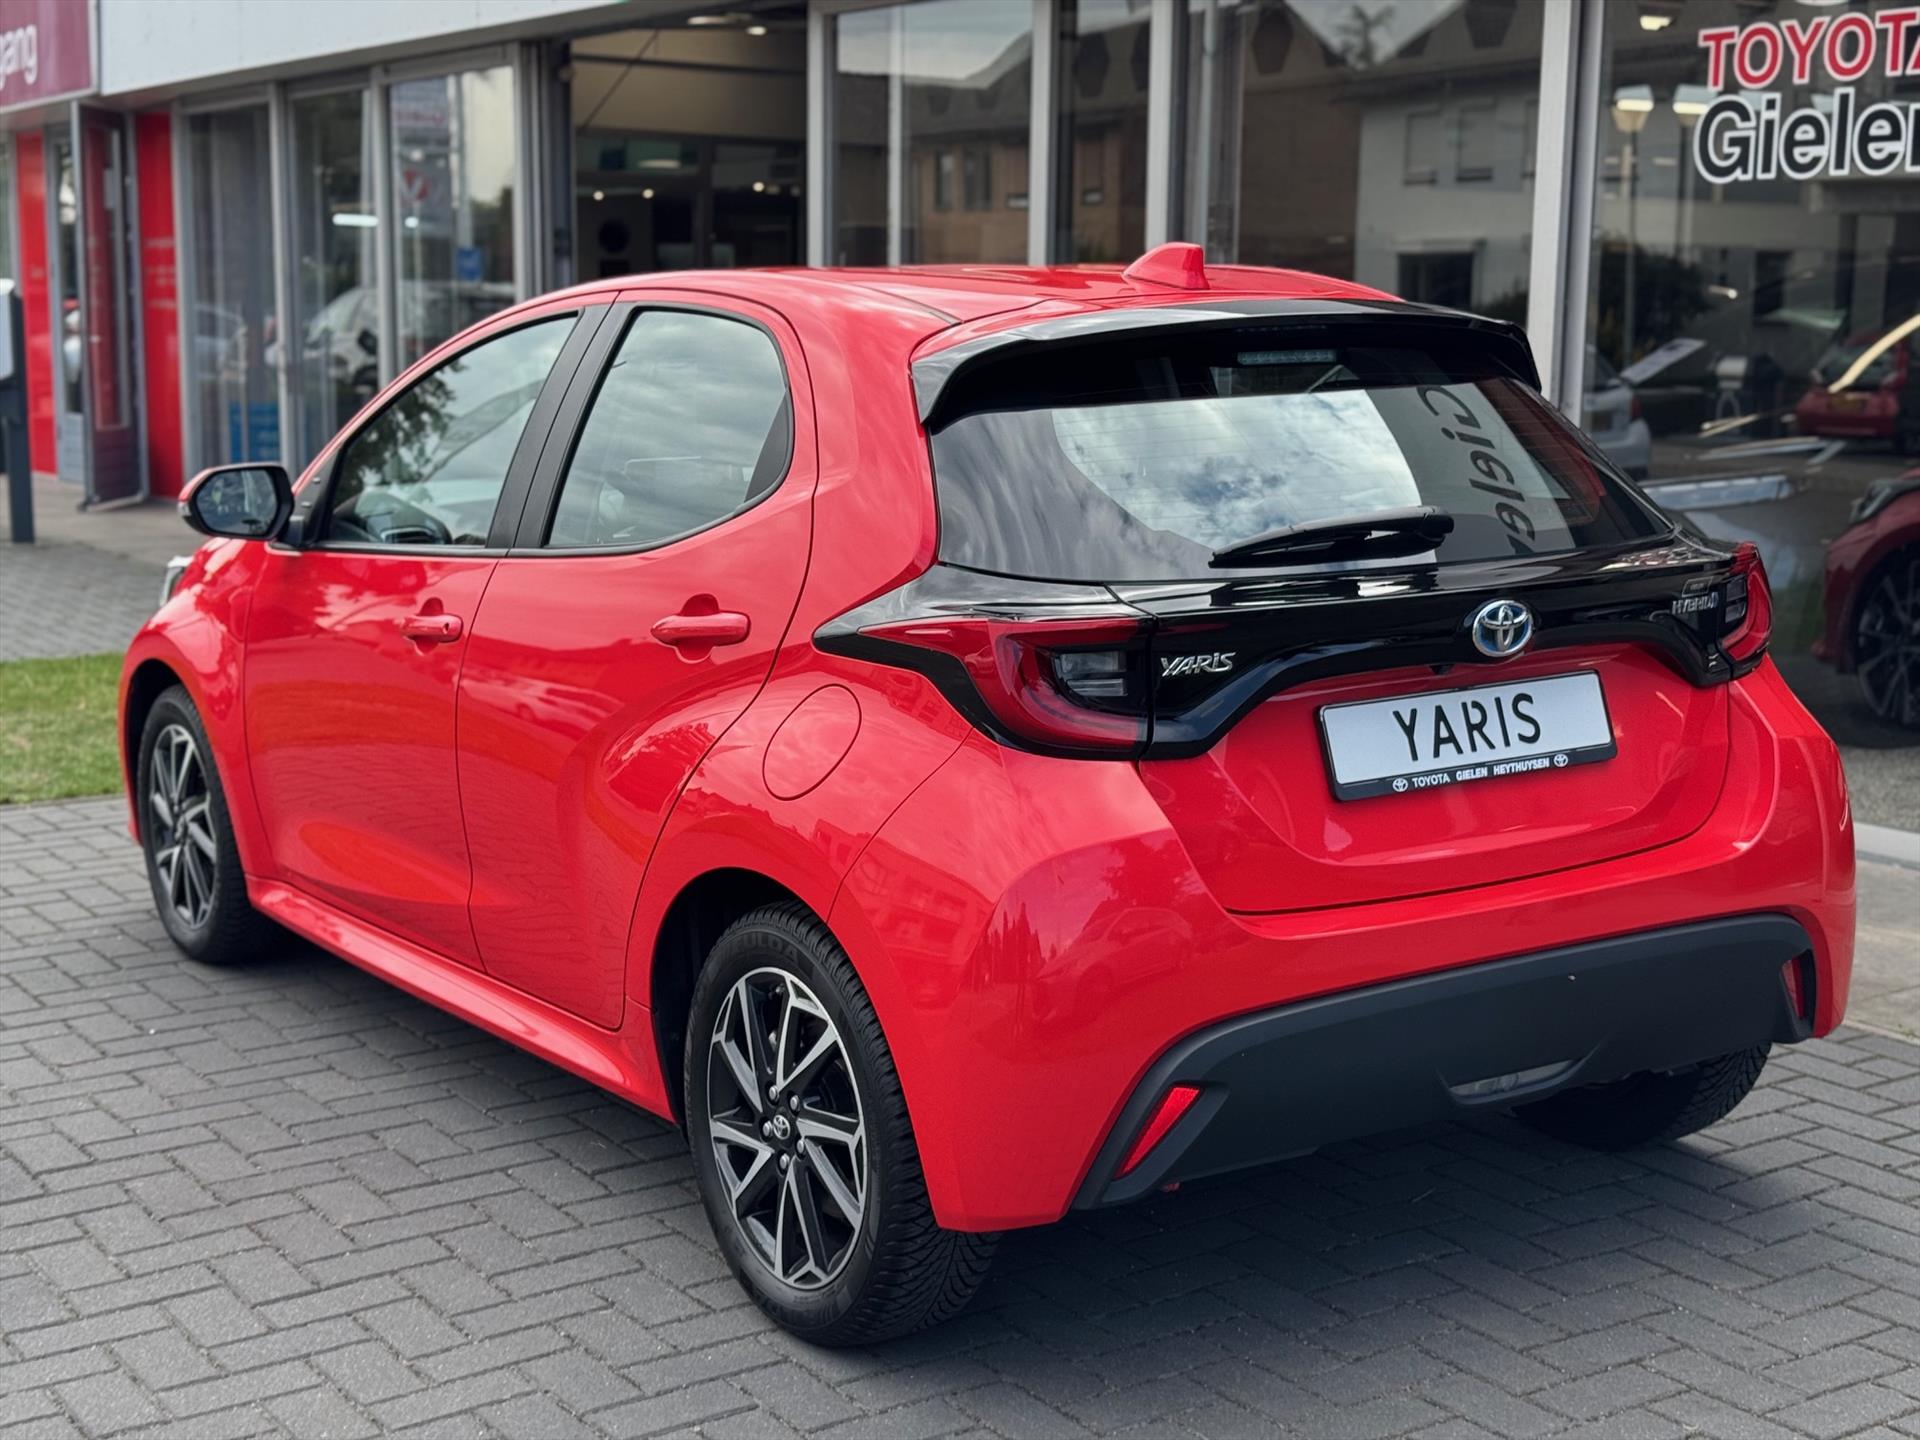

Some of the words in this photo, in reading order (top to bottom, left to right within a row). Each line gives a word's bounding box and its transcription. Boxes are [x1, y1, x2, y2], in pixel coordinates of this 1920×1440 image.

[1698, 7, 1920, 91] TOYOT
[1693, 87, 1920, 184] Giele
[1160, 652, 1236, 677] YARIS
[1392, 693, 1541, 762] YARIS
[1412, 773, 1450, 788] TOYOTA
[1456, 767, 1488, 781] GIELEN
[1493, 757, 1550, 776] HEYTHUYSEN
